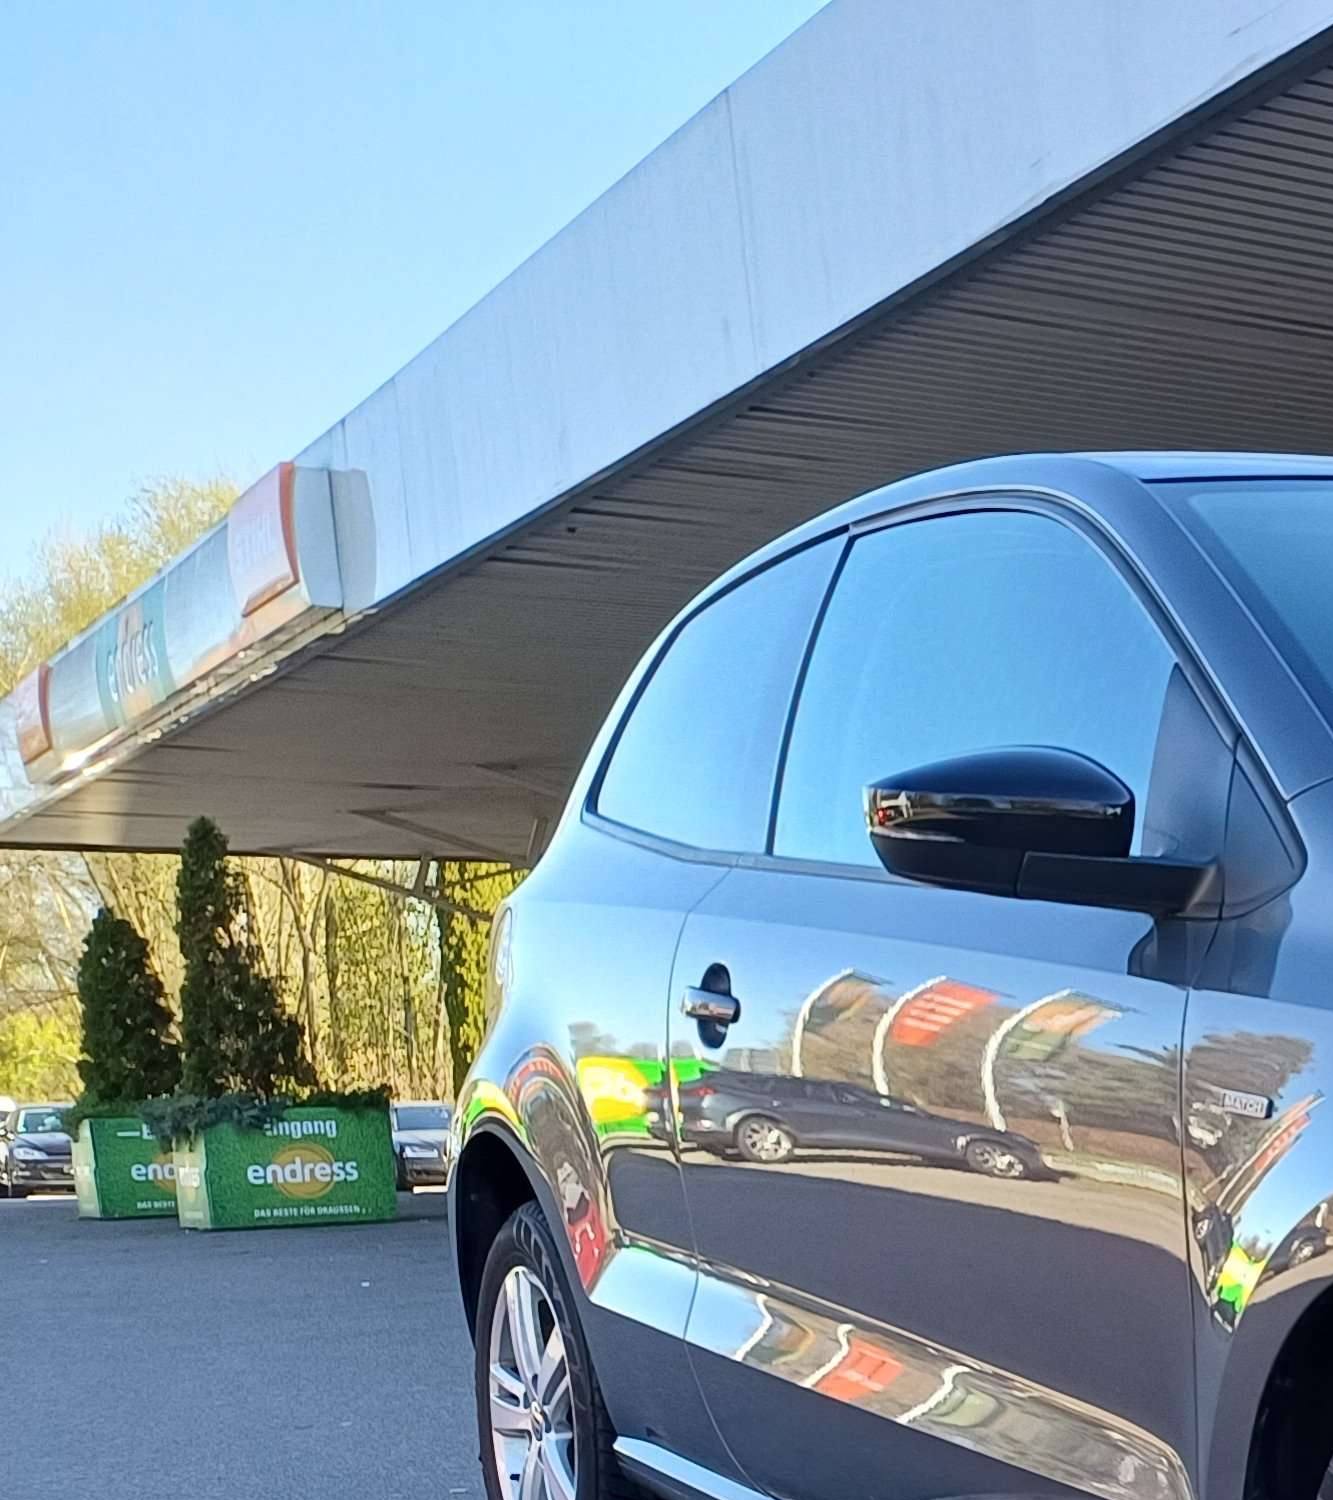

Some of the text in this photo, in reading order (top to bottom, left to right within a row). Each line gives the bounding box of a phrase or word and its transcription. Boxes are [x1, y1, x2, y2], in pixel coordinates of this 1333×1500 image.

[246, 1156, 360, 1185] endress
[254, 1208, 271, 1218] DAS
[273, 1206, 299, 1217] BESTE
